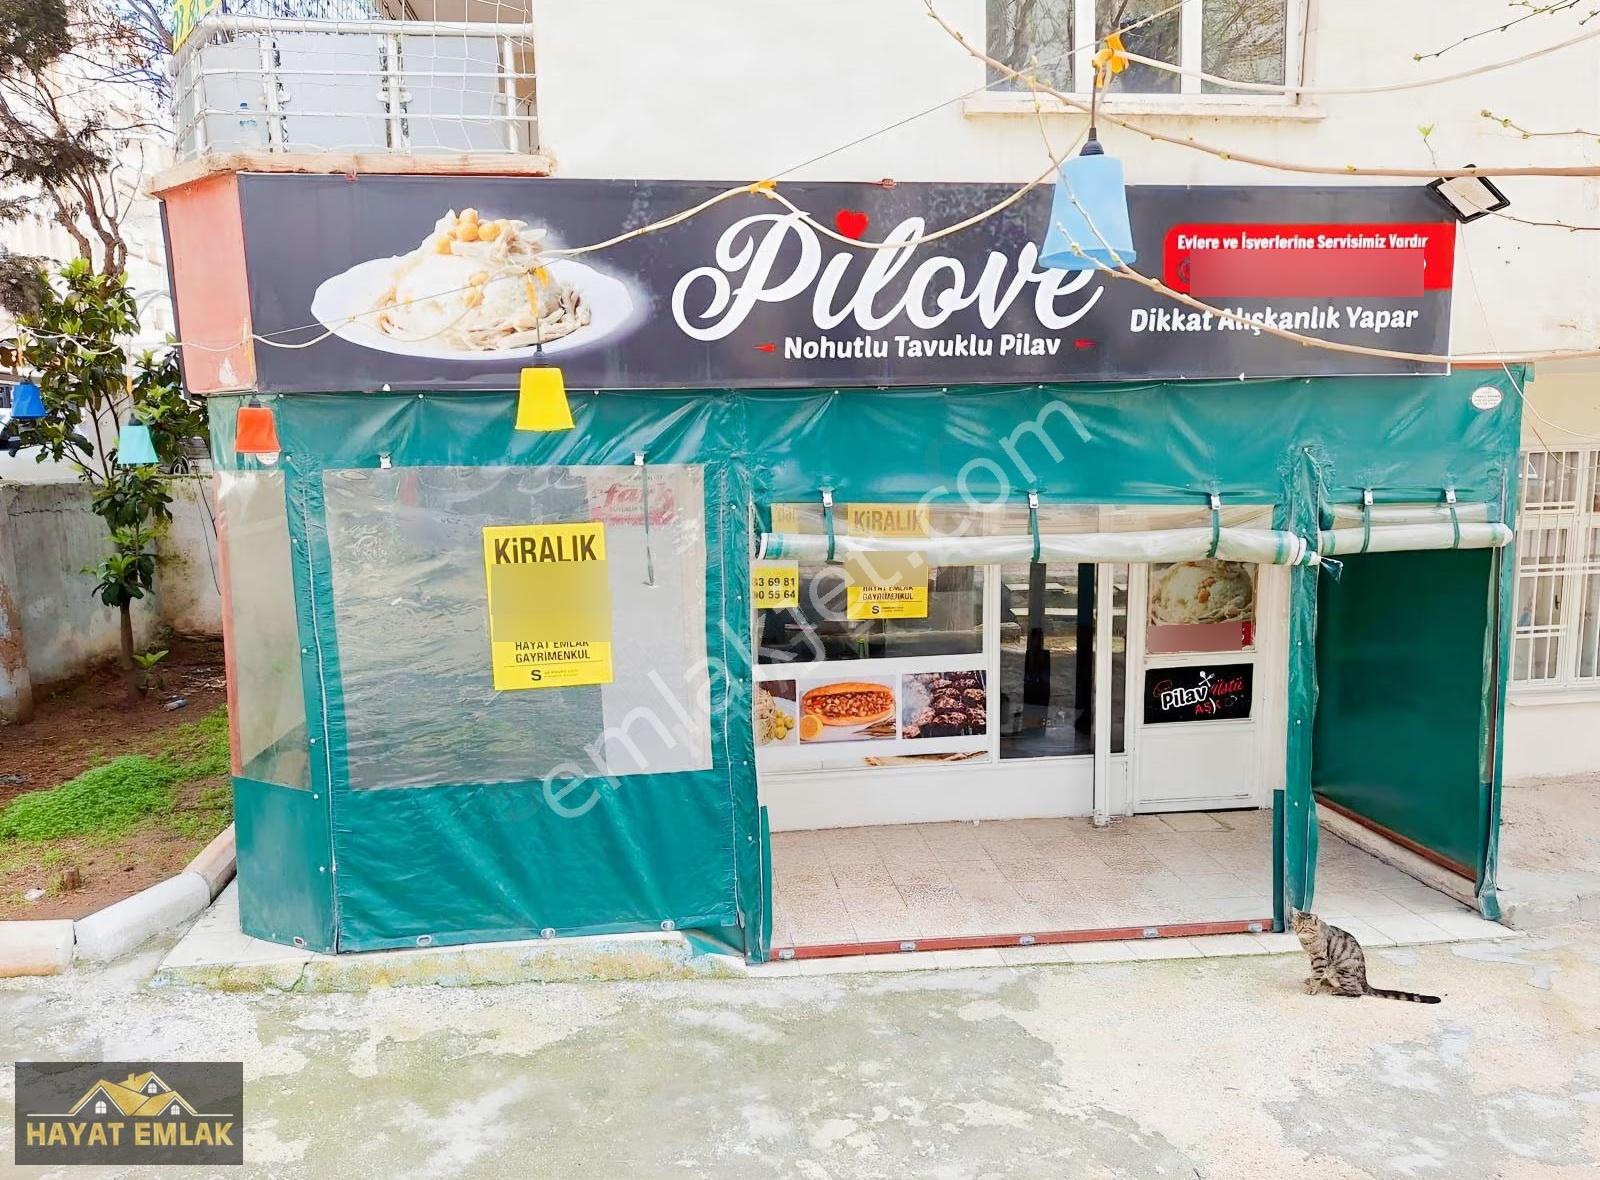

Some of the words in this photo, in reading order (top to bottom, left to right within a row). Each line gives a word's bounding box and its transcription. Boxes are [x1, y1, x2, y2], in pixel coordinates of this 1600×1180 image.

[1177, 234, 1219, 250] Evlere
[1223, 237, 1238, 250] ve
[1317, 233, 1386, 249] Servisimiz
[1389, 233, 1428, 249] Vardır
[671, 210, 1105, 341] Pilove
[1130, 307, 1212, 332] Dikkat
[1217, 306, 1341, 336] Alışkanlık
[1345, 306, 1419, 333] Yapar
[784, 335, 888, 360] Nohutlu
[894, 334, 993, 358] Tavuklu
[999, 333, 1061, 356] Pilav
[768, 577, 780, 587] 69
[783, 577, 795, 587] 81
[768, 590, 780, 599] 55
[783, 589, 796, 599] 64
[515, 649, 591, 664] GAYRİMENKUL
[1161, 686, 1208, 711] Pilav
